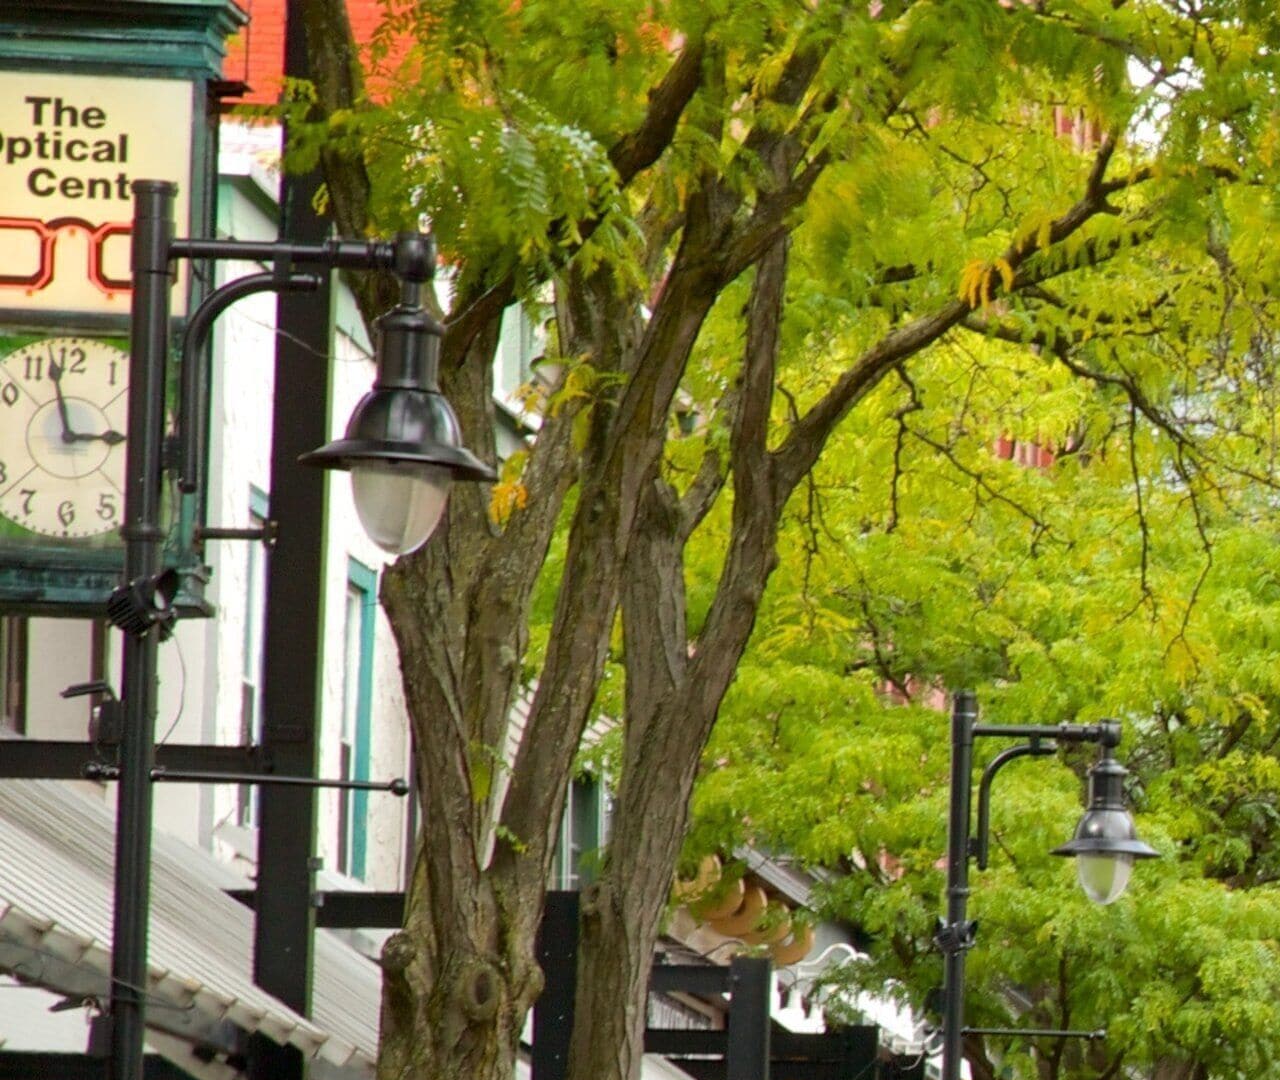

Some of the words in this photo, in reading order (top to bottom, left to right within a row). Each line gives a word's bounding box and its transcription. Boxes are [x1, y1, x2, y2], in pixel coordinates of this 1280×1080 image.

[24, 95, 106, 129] The
[0, 131, 128, 165] ptical
[27, 167, 130, 200] Cent
[1, 382, 19, 407] 0
[20, 489, 36, 516] 7
[58, 501, 75, 527] 6
[96, 493, 115, 520] 5
